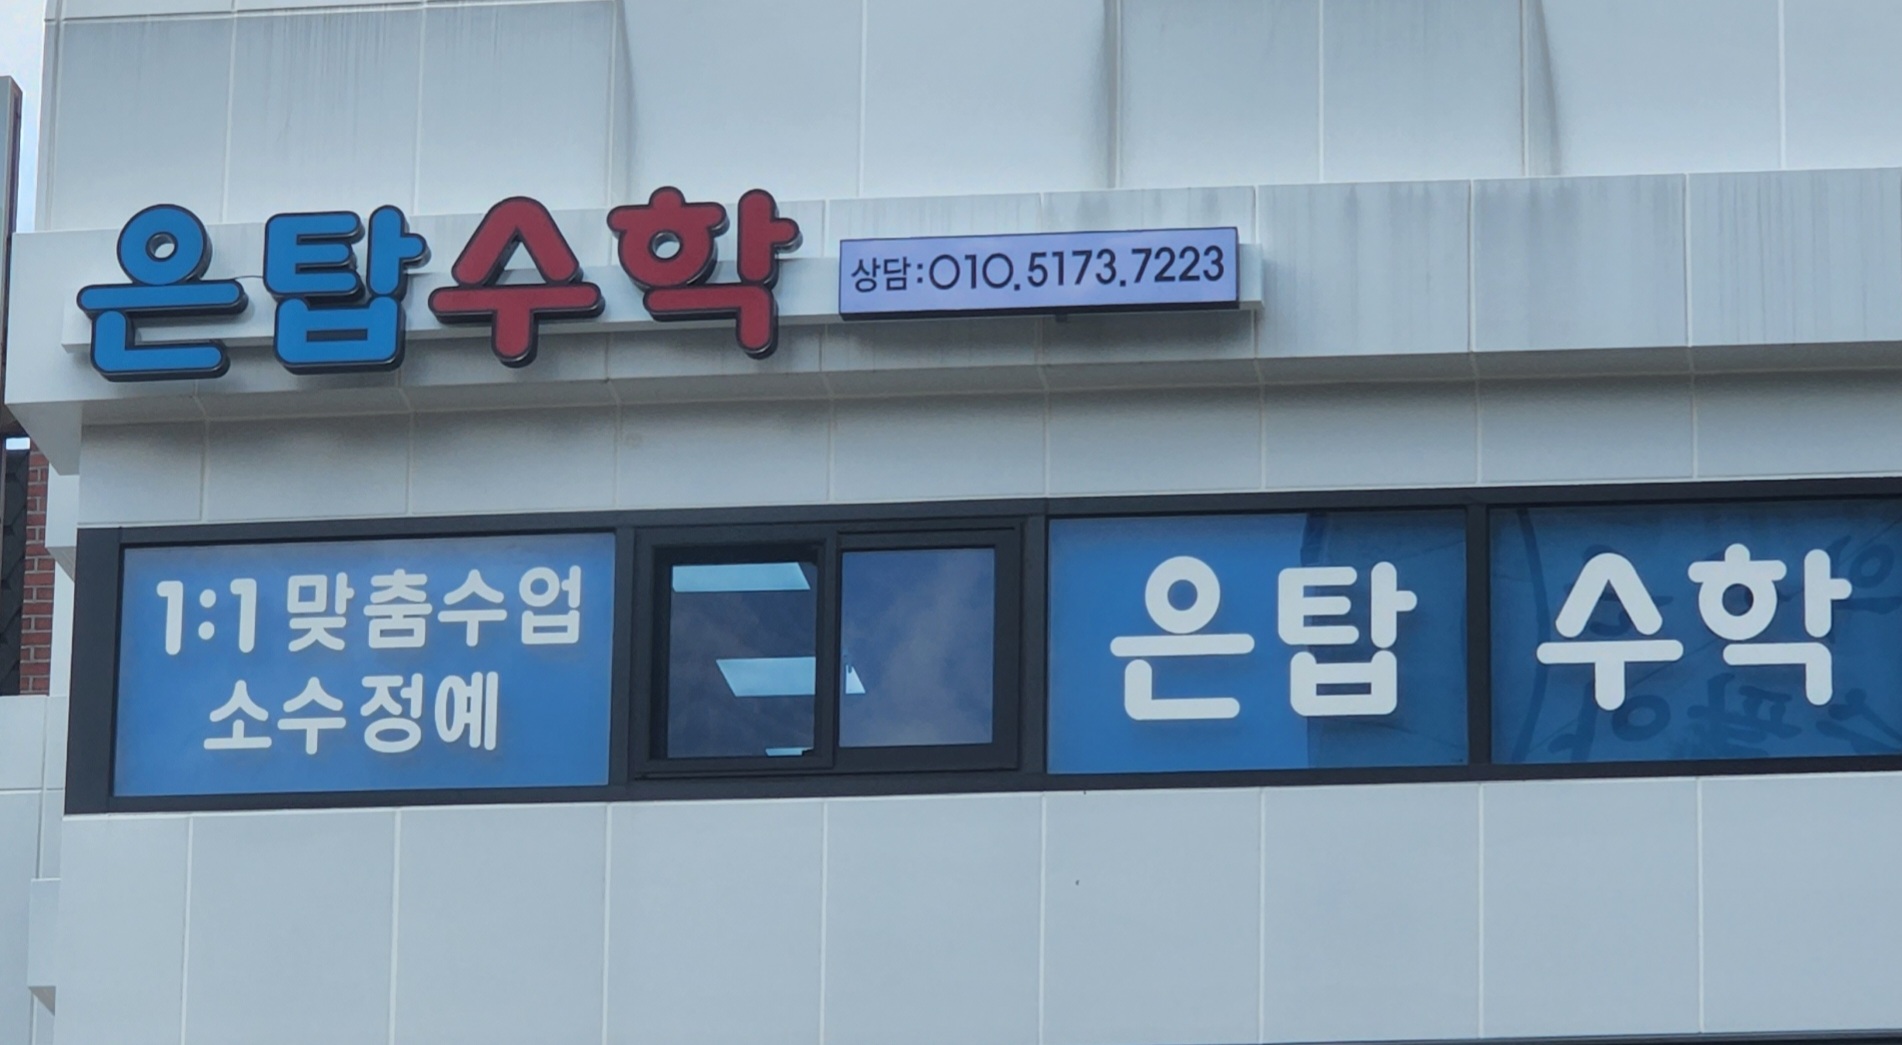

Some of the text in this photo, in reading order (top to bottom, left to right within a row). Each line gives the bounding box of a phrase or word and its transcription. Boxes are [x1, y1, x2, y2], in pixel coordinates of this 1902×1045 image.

[156, 565, 582, 656] 1:1 맞춤수업
[1110, 555, 1418, 720] 은탑
[1536, 543, 1853, 711] 수학
[203, 671, 498, 755] 소수정예
